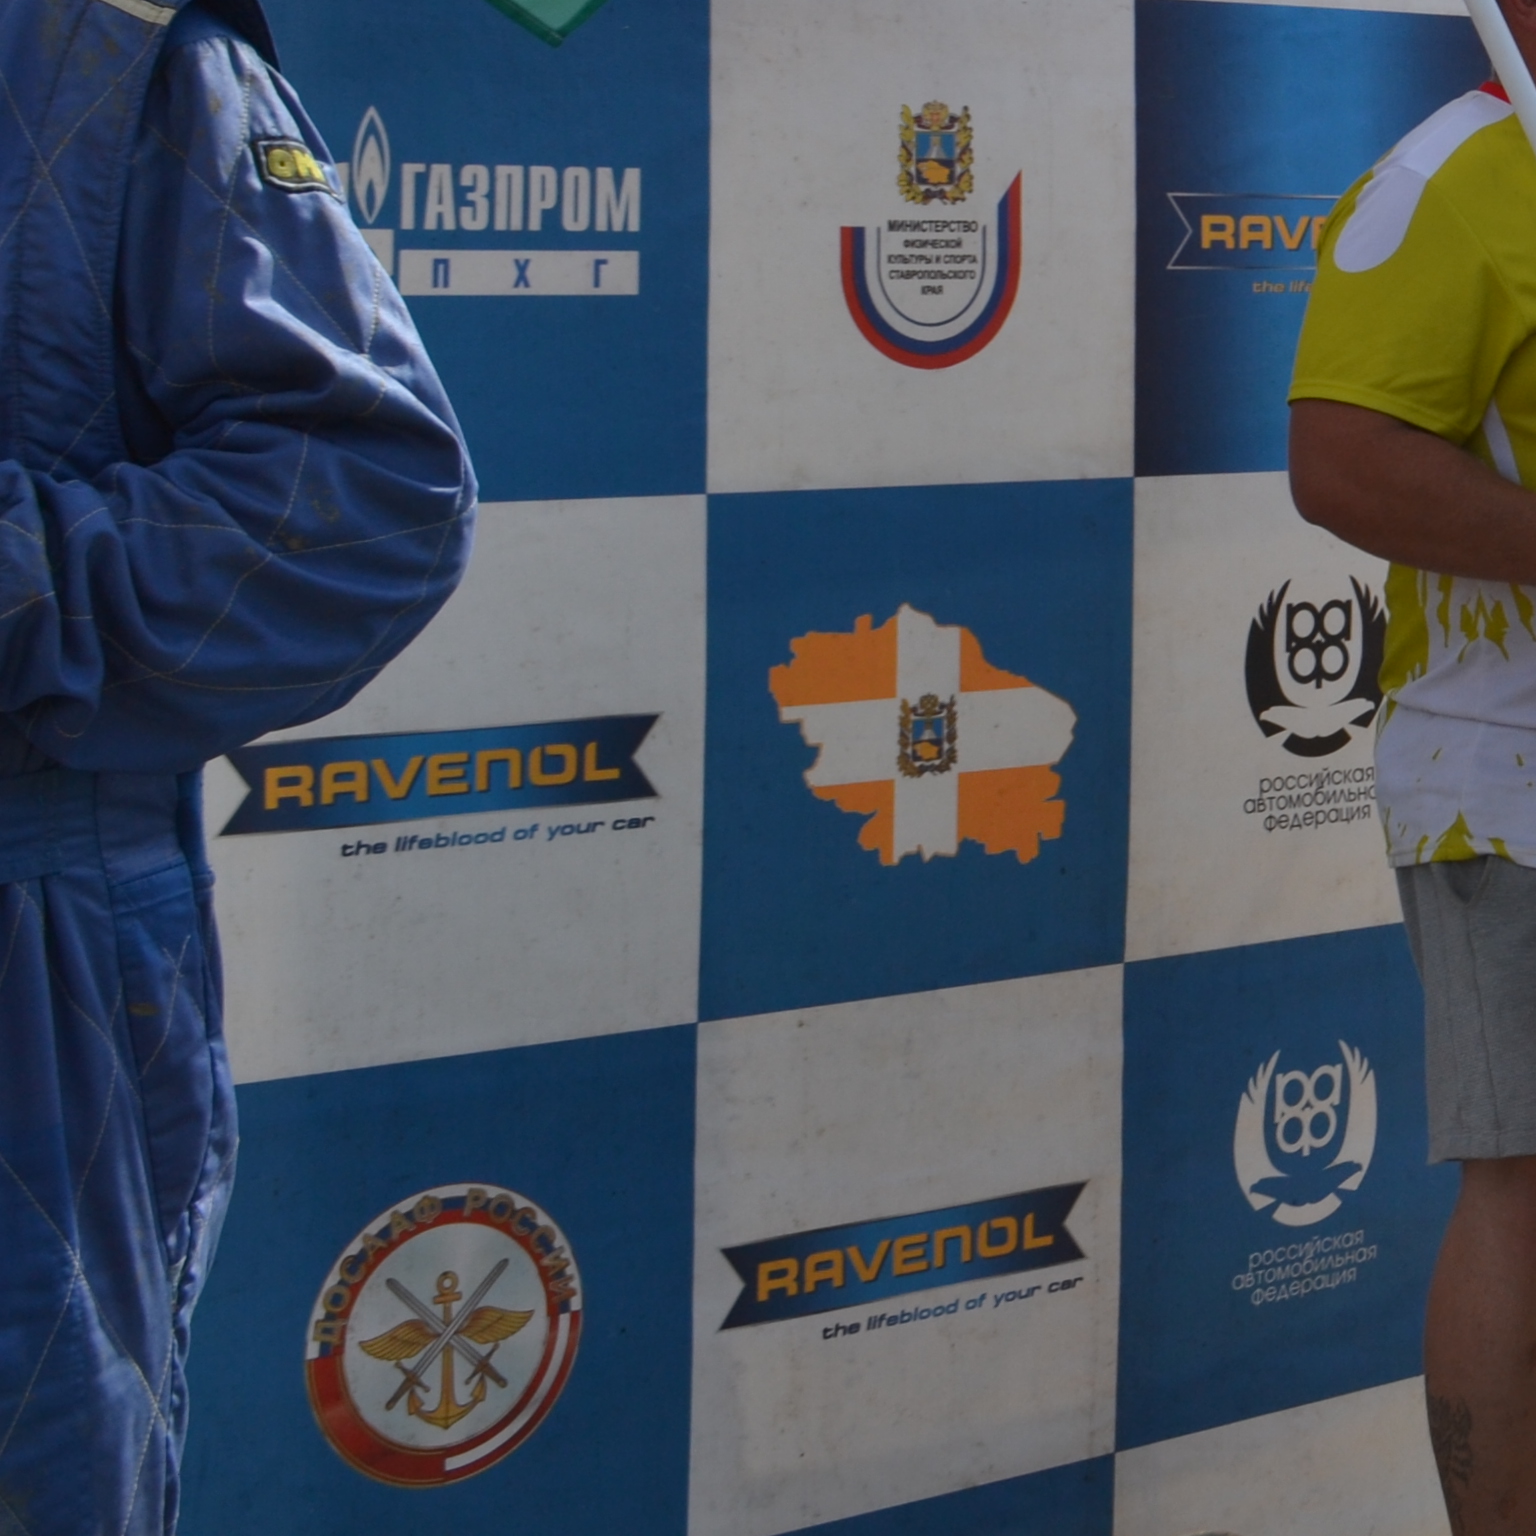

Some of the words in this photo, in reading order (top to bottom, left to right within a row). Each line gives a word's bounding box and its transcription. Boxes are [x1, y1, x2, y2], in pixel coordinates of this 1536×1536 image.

[401, 162, 641, 233] ГАЗПРОМ
[886, 219, 979, 233] МИНИСТЕРСТВО
[903, 237, 963, 249] ФИЗИЧЕСКОЙ
[886, 253, 932, 265] КУЛЬТУРЫ
[943, 253, 978, 265] СПОРТА
[888, 268, 977, 281] СТАВРОПОЛЬСКОГО
[920, 284, 944, 296] КРАЯ
[1253, 280, 1285, 293] the
[263, 741, 622, 812] RAVENOL
[1259, 766, 1376, 796] российская
[1243, 783, 1377, 815] автомобильн
[340, 840, 388, 858] the
[394, 826, 506, 853] lifeblood
[513, 823, 542, 842] of
[546, 821, 605, 841] your
[611, 814, 656, 832] car
[1263, 803, 1372, 834] федерация
[313, 1194, 443, 1345] ДОСААФ
[463, 1187, 578, 1305] РОССИИ
[755, 1211, 1055, 1303] RAVENOL
[1231, 1244, 1378, 1291] автомобильная
[1248, 1229, 1365, 1272] российская
[1250, 1267, 1357, 1306] федерация
[822, 1321, 860, 1340] the
[865, 1298, 960, 1331] lifeblood
[964, 1293, 987, 1311] of
[992, 1285, 1042, 1308] your
[1047, 1275, 1085, 1294] car
